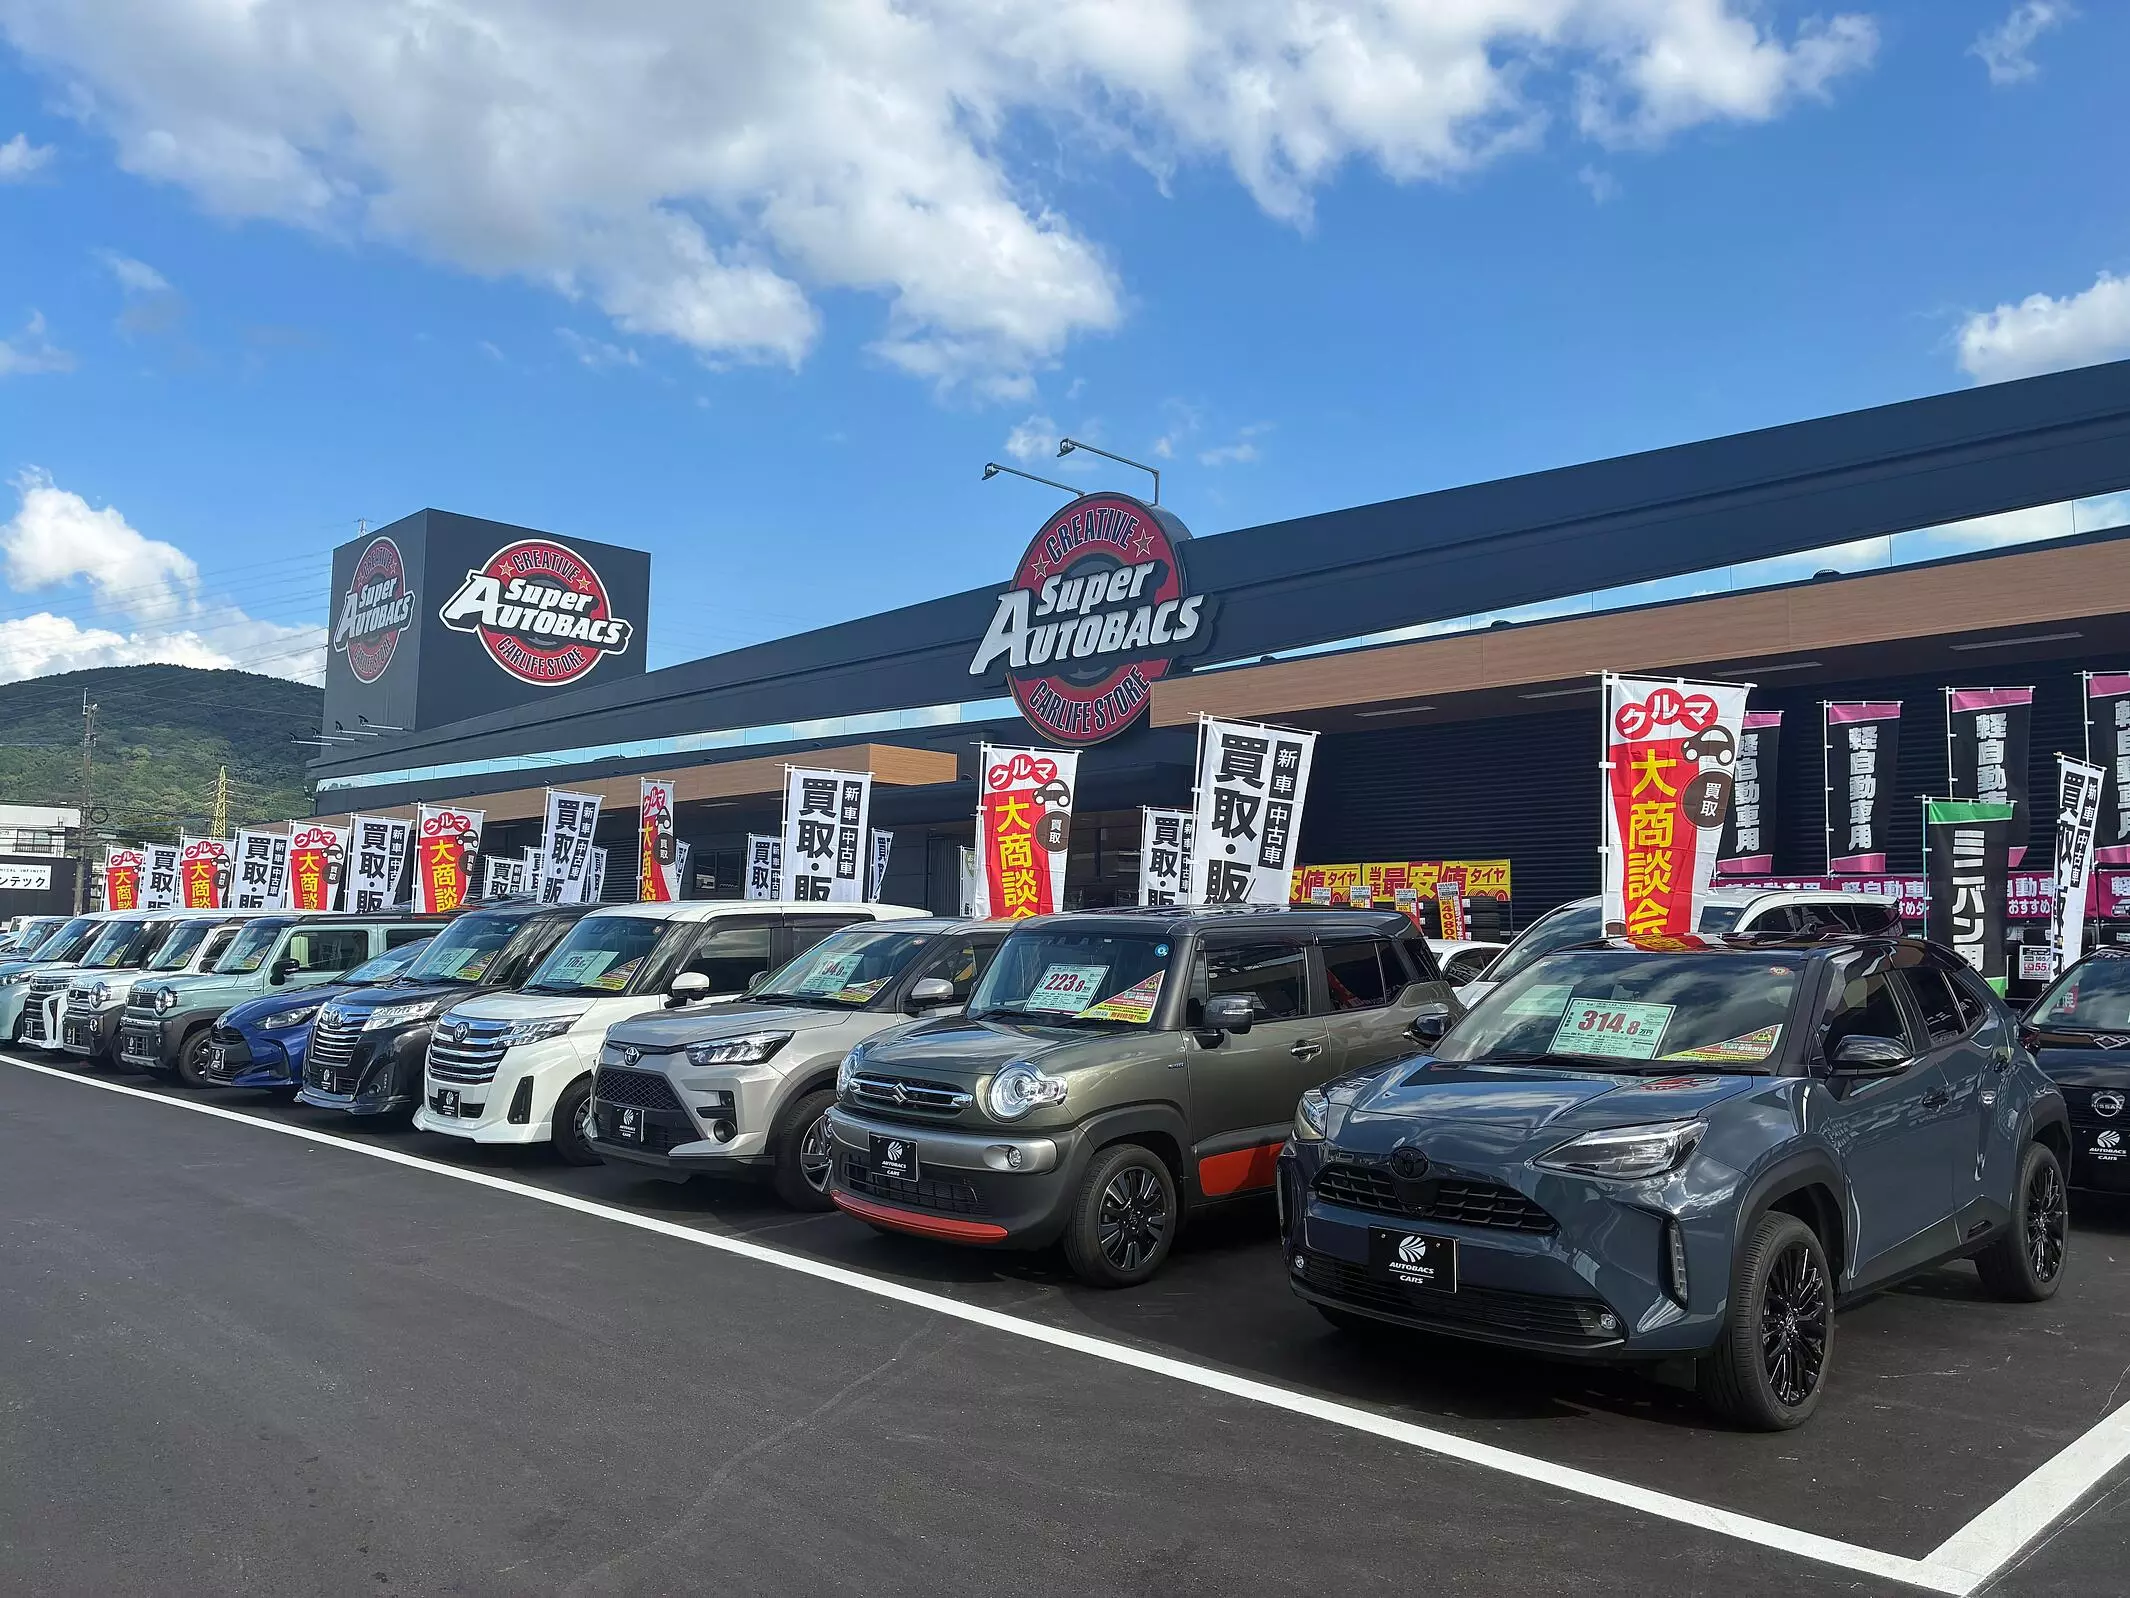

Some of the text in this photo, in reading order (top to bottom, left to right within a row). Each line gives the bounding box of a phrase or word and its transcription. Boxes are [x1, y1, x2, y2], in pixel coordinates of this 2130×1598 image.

[1044, 508, 1140, 565] CREATIVE
[511, 551, 581, 582] CREATIVE
[360, 577, 398, 609] Super
[505, 579, 596, 613] Super
[1036, 561, 1156, 616] Super
[336, 593, 411, 643] AUTOBACS
[443, 573, 624, 645] AUTOBACS
[968, 588, 1204, 675] AUTOBACS
[497, 638, 586, 677] CARLIFE STORE
[1028, 665, 1151, 734] CARLIFE STORE
[1621, 694, 1713, 734] クルマ
[992, 758, 1054, 787] クルマ
[1273, 748, 1297, 793] 新車
[843, 787, 860, 820] 新車
[1700, 782, 1722, 817] 買取
[1848, 725, 1878, 851] 軽自動車用
[425, 814, 467, 834] クルマ
[581, 806, 594, 835] 新車
[1049, 820, 1062, 844] 買取
[1263, 806, 1287, 864] 中古車
[186, 842, 223, 857] クルマ
[274, 842, 286, 863] 新車
[296, 830, 334, 847] クルマ
[391, 829, 404, 853] 新車
[660, 839, 669, 859] 買取
[840, 830, 856, 875] 中古車
[1629, 748, 1677, 935] 大商談会
[430, 839, 458, 913] 大商談
[570, 842, 588, 878] 中古車
[1471, 868, 1505, 884] タイヤ
[269, 868, 282, 896] 中古車
[1328, 871, 1357, 885] タイヤ
[1044, 973, 1085, 992] 223.8
[1578, 1010, 1641, 1035] 314.8
[1389, 1262, 1434, 1273] AUTOBACS
[1400, 1275, 1423, 1283] CARS
